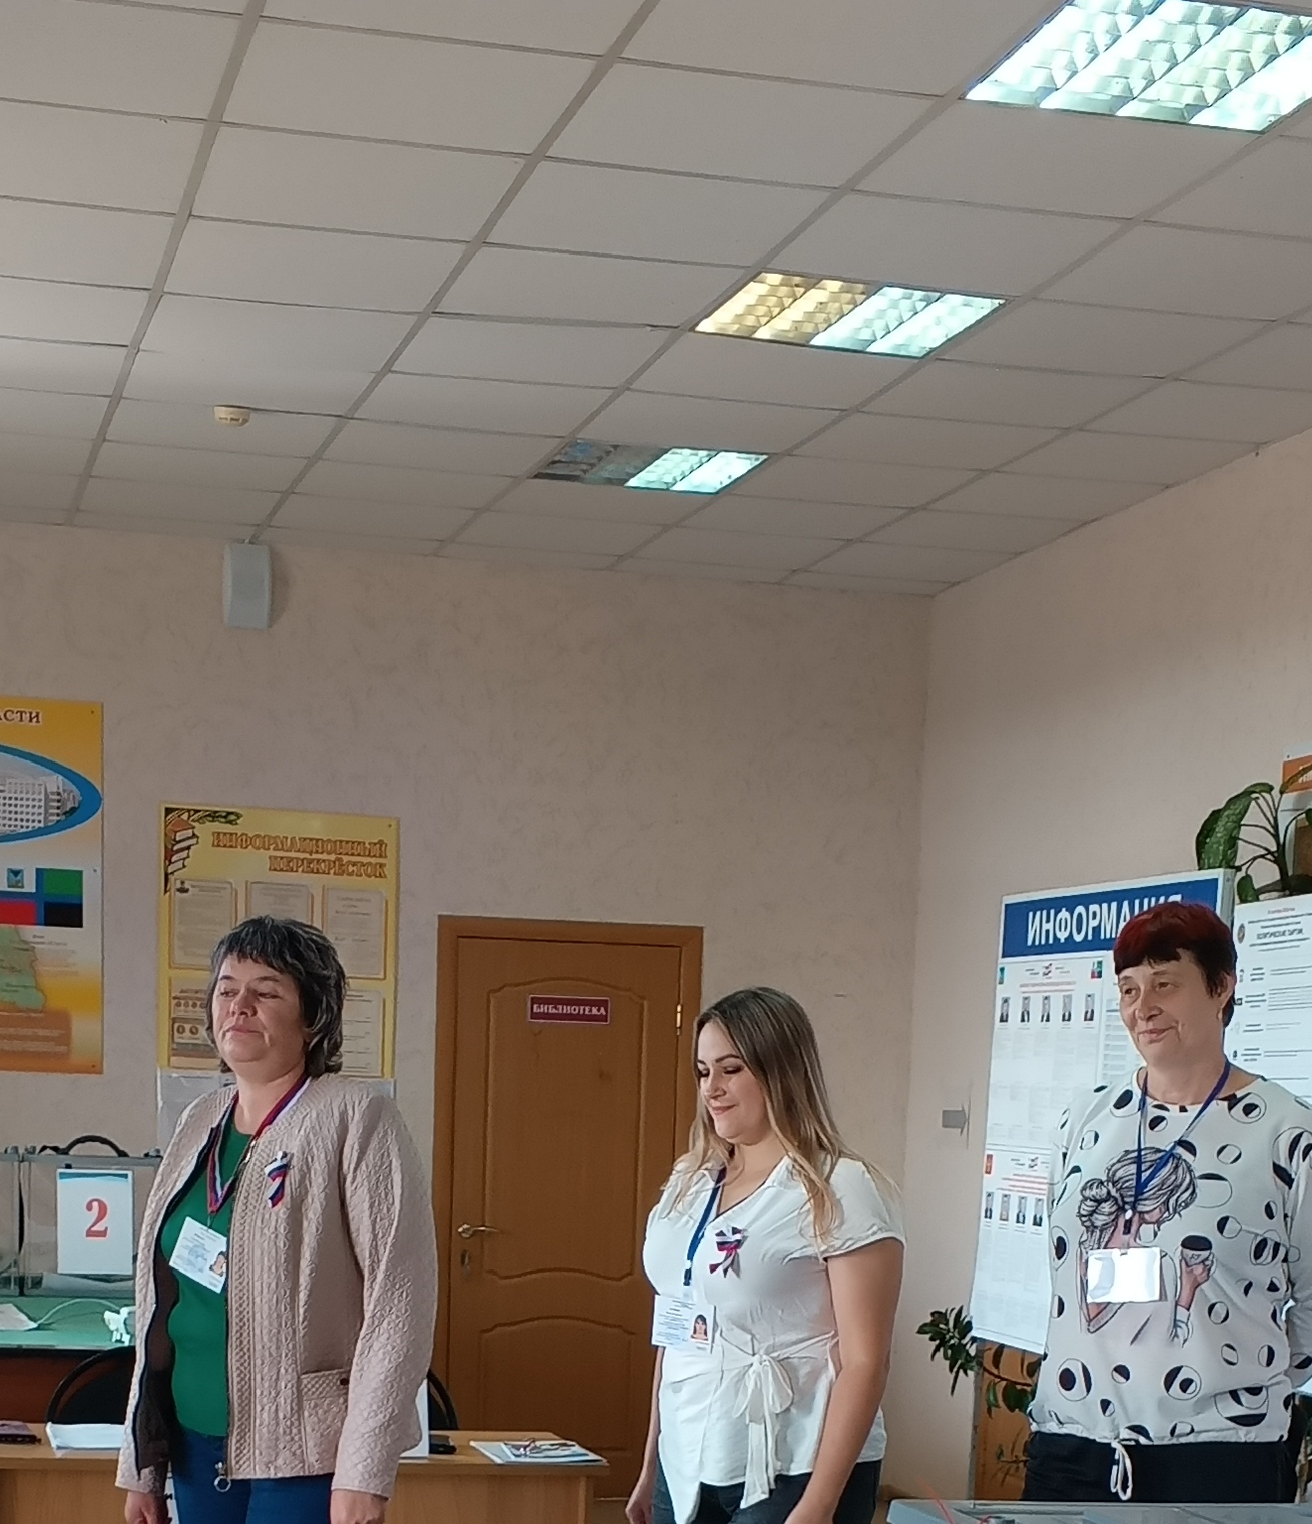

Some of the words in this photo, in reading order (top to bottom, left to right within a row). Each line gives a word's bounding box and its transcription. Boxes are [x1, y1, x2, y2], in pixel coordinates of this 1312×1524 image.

[212, 831, 388, 858] ИНФОРМАЦИОННЫЙ
[268, 855, 388, 878] ПЕРЕКРЁСТОК
[1027, 894, 1183, 947] ИНФОРМА
[533, 1004, 606, 1016] БИБЛИОТЕКА
[85, 1198, 108, 1238] 2
